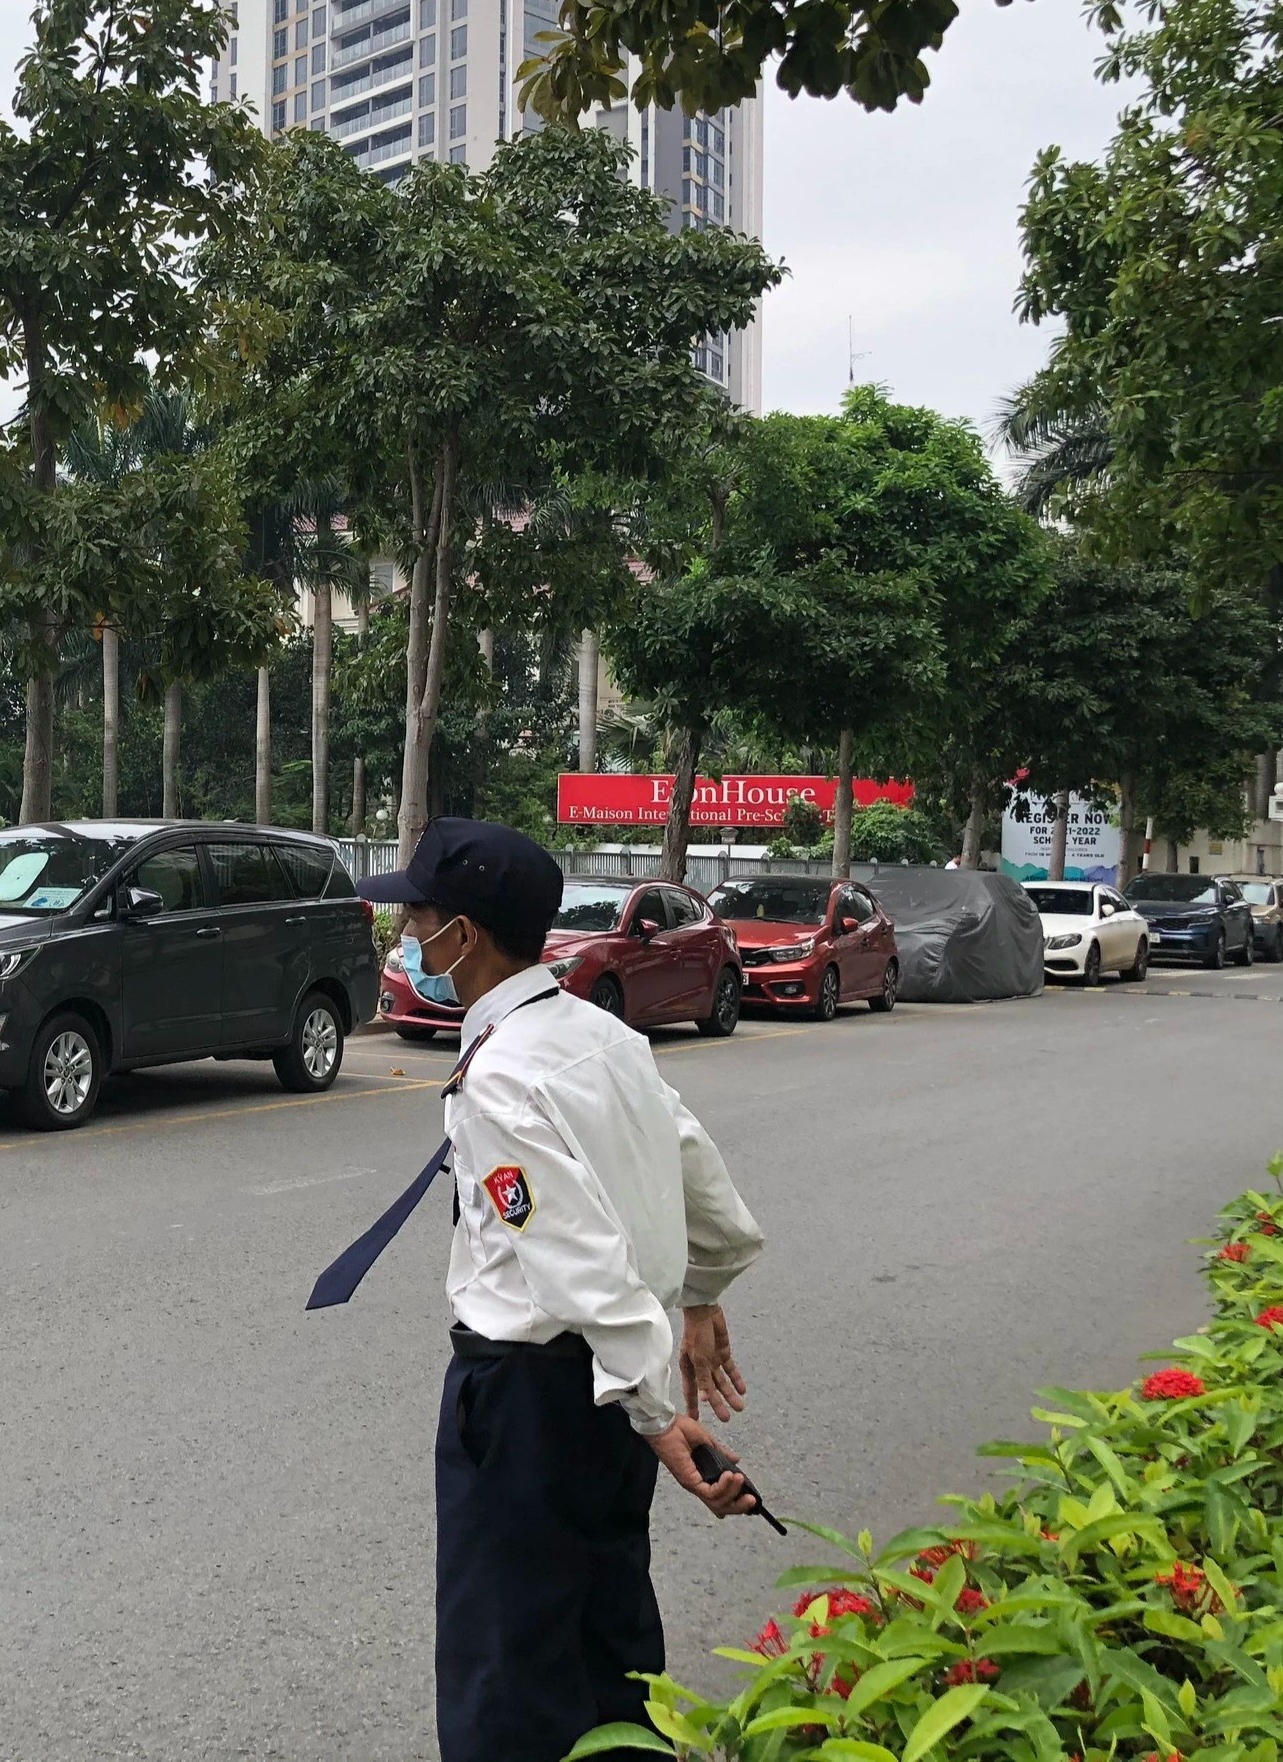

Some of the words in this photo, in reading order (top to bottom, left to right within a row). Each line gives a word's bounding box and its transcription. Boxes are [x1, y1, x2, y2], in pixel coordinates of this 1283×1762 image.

[651, 779, 815, 804] EnHouse
[569, 806, 633, 820] E-Maison
[638, 806, 731, 821] Intetional
[738, 808, 785, 822] Pre-Sc
[1030, 826, 1047, 835] FOR
[1051, 826, 1100, 836] 21-2022
[1033, 836, 1068, 845] SCH
[1072, 837, 1096, 845] YEAR
[502, 1203, 530, 1219] SECURITY
